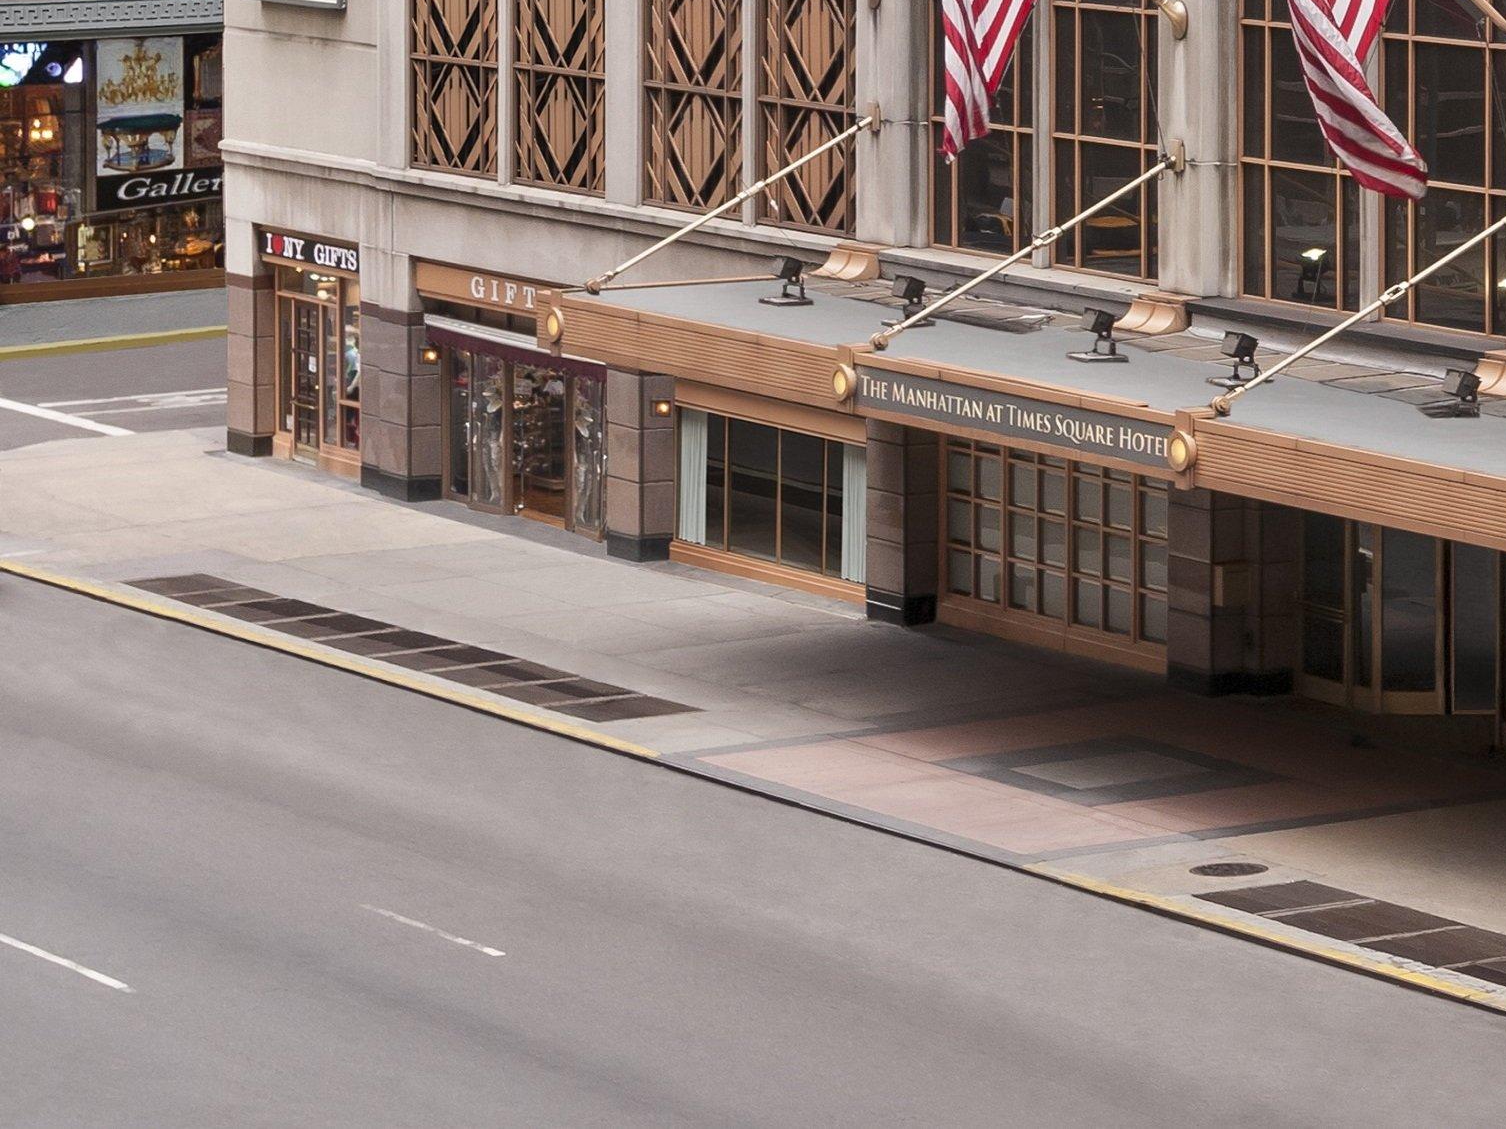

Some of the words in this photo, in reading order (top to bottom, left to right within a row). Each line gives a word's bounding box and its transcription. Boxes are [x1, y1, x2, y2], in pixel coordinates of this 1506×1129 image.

[283, 236, 305, 260] NY
[314, 243, 357, 271] GIFTS
[470, 276, 536, 309] GIFT
[860, 374, 888, 401] THE
[892, 381, 983, 420] MANHATTAN
[985, 403, 1004, 423] AT
[1006, 404, 1051, 434] TIMES
[1054, 413, 1115, 447] SQUARE
